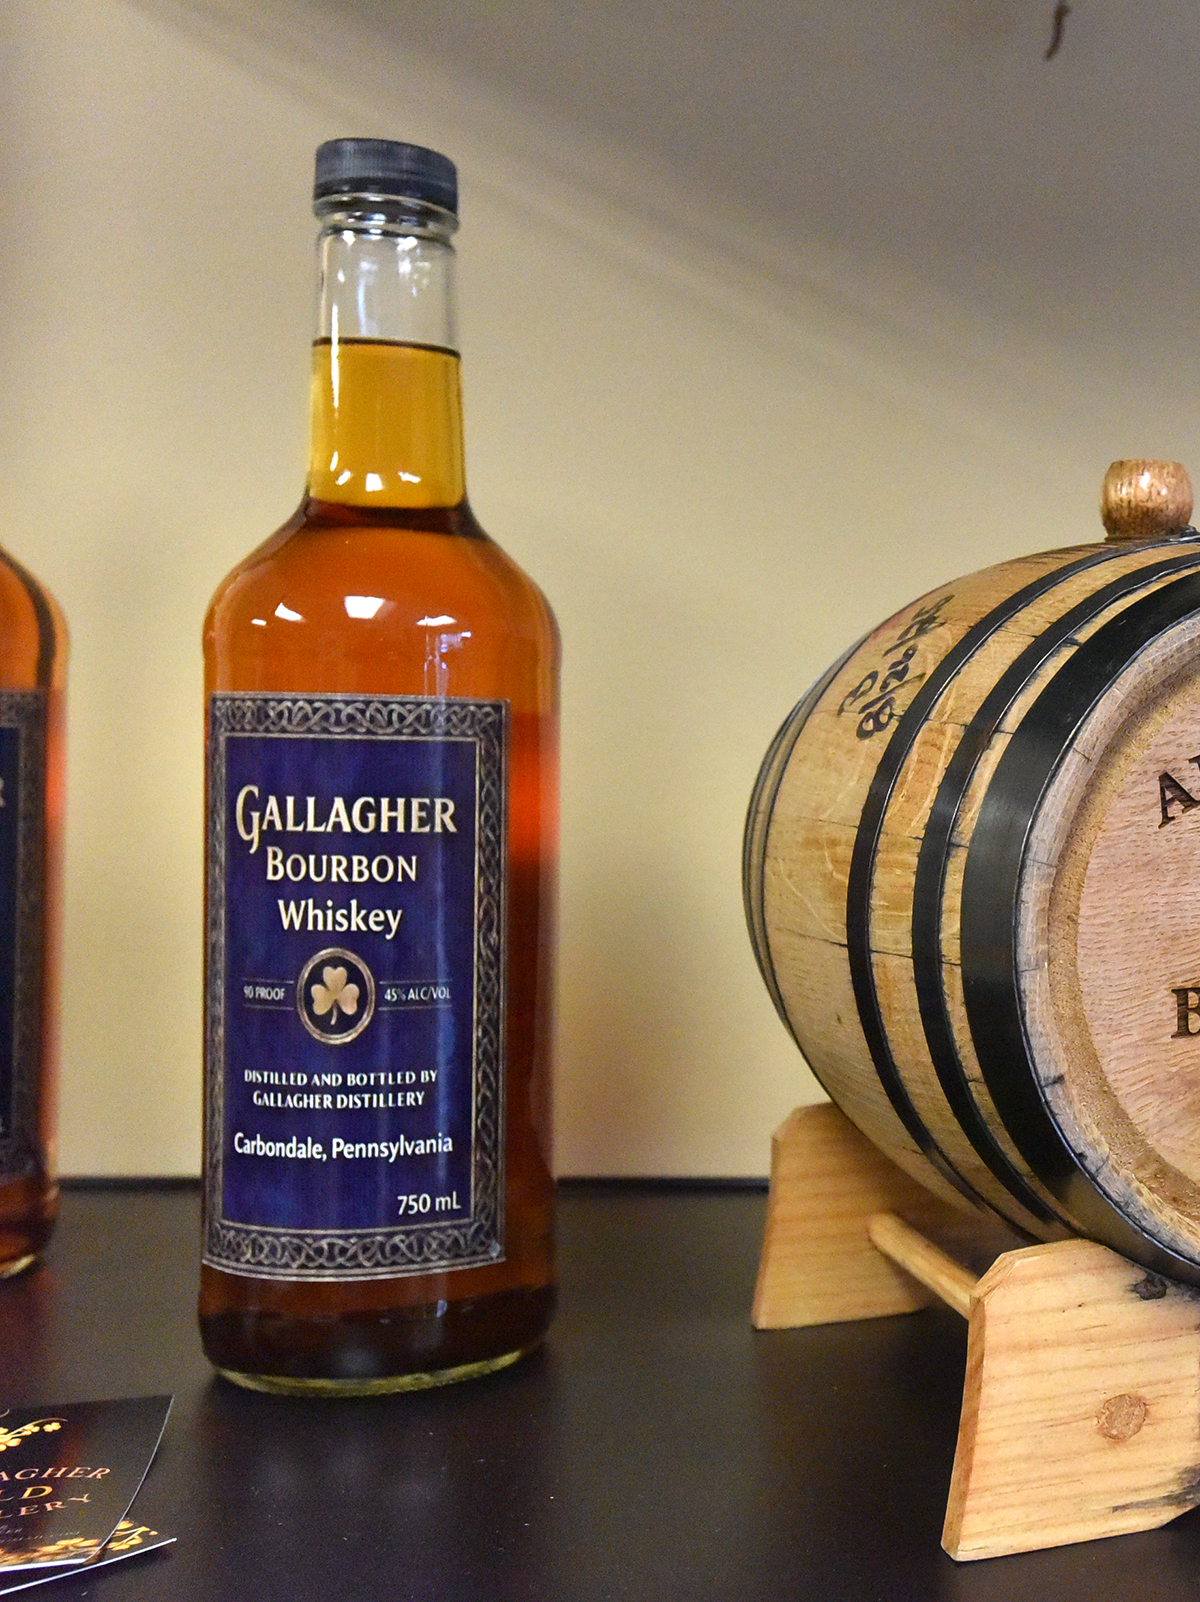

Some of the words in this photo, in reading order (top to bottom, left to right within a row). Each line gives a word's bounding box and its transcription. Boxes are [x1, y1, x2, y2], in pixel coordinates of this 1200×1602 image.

[235, 785, 457, 854] GALLAGHER
[266, 846, 417, 883] BOURBON
[278, 899, 402, 940] Whiskey
[243, 985, 254, 999] 90
[256, 986, 286, 1001] PROOF
[407, 986, 451, 1001] ALC/VOL
[244, 1069, 308, 1085] DISTILLED
[311, 1072, 342, 1087] AND
[349, 1070, 416, 1086] BOTTLED
[420, 1069, 438, 1083] BY
[253, 1090, 333, 1109] GALLAGHER
[336, 1091, 425, 1109] DISTILLERY
[234, 1131, 327, 1162] Carbondale,
[332, 1132, 453, 1163] Pennsylvania
[397, 1194, 431, 1216] 750
[435, 1190, 461, 1211] mL
